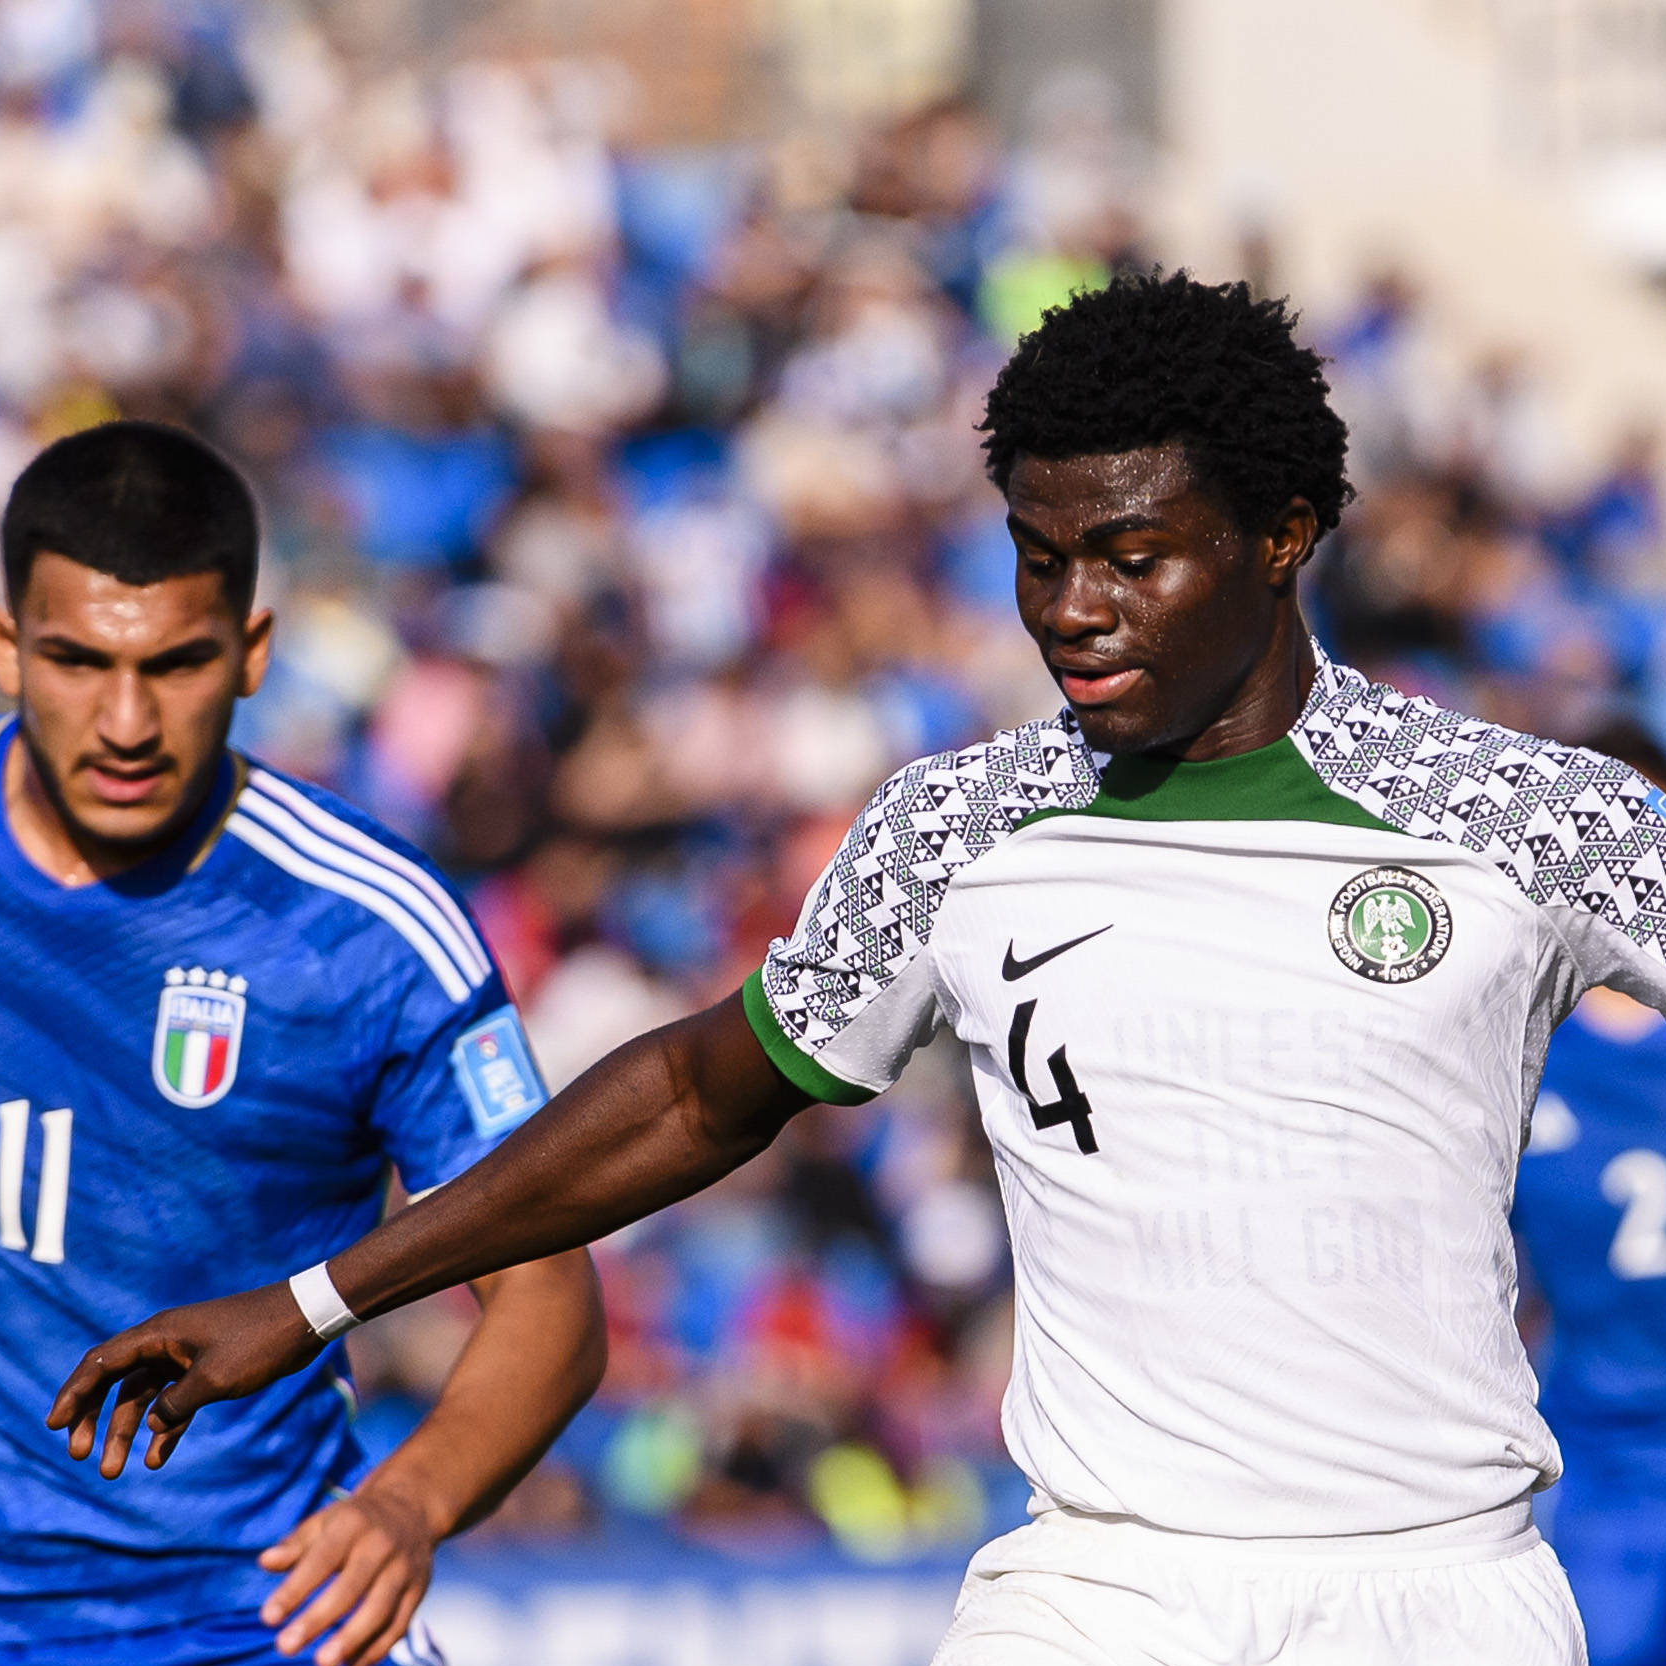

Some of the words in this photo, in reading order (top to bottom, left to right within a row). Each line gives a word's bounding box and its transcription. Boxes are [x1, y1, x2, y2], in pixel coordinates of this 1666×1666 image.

[1330, 909, 1364, 971] NIGE
[1407, 874, 1450, 960] FEDERATION
[1008, 998, 1101, 1155] 4
